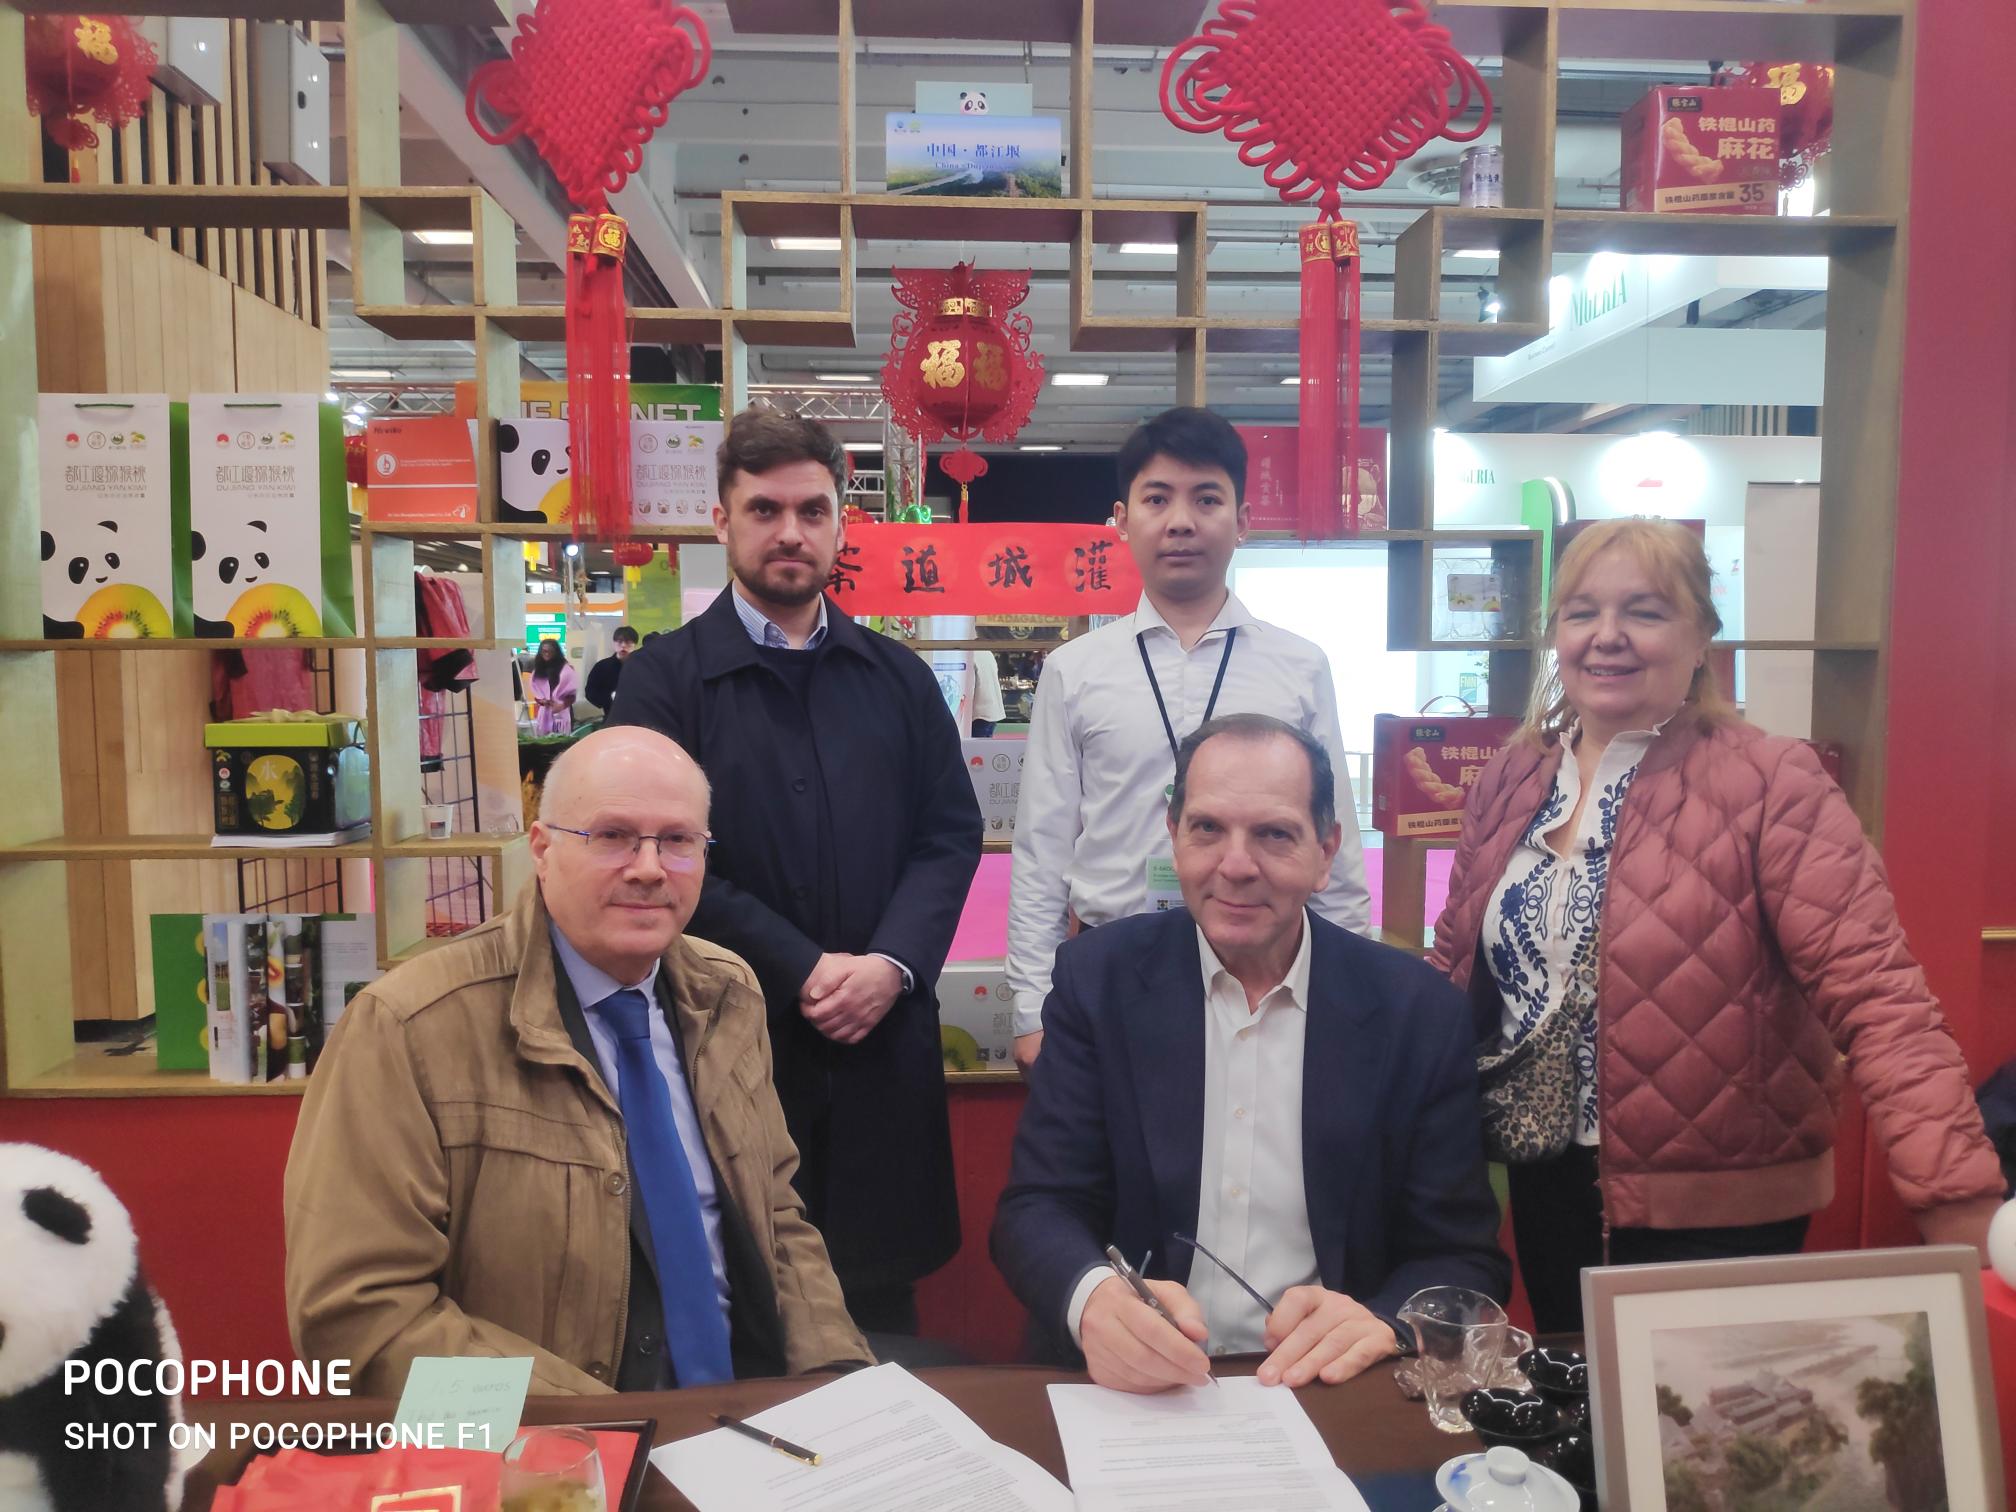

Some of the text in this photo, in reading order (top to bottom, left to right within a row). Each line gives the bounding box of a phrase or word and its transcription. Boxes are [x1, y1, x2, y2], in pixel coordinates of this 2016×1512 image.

[1698, 116, 1776, 133] 铁棍山药
[1717, 136, 1775, 160] 麻花
[920, 339, 965, 390] 福
[1441, 745, 1508, 761] 铁棍山
